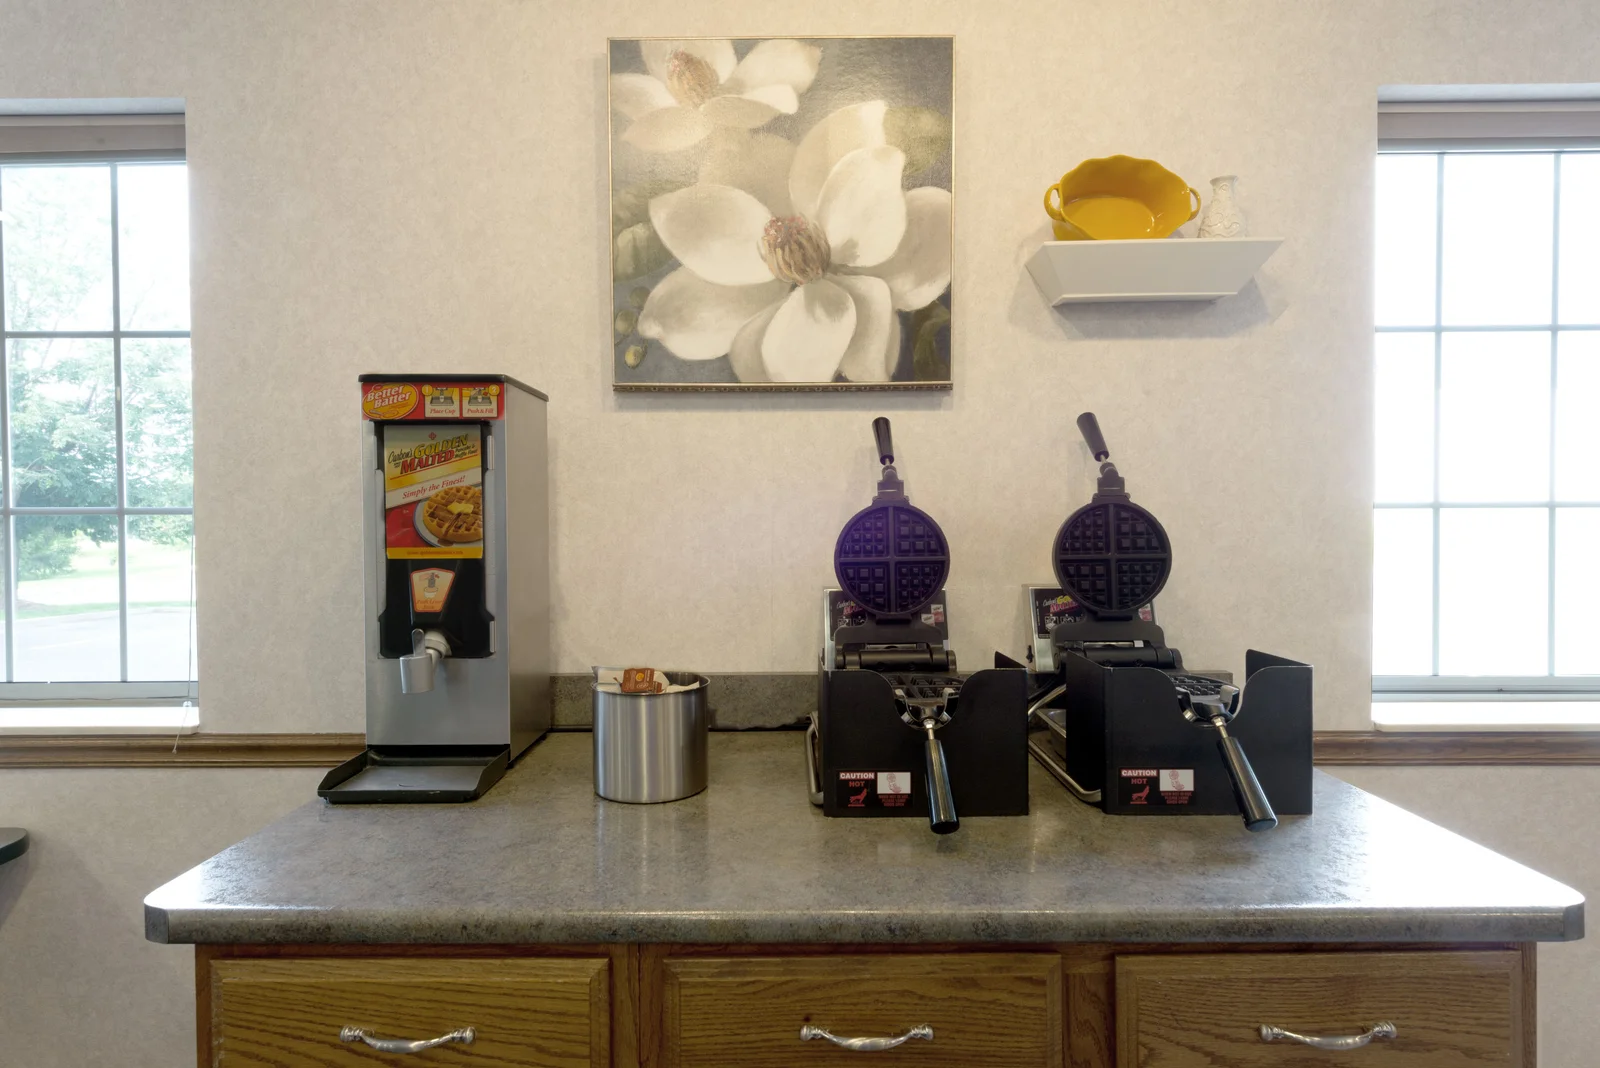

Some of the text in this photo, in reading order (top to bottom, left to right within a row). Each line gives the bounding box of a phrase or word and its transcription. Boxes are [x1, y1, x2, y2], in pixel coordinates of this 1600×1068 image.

[366, 385, 405, 402] Better
[374, 391, 411, 409] Batter
[414, 433, 469, 459] GOLDEN
[400, 449, 455, 474] MALTED
[402, 475, 466, 499] Simply the Finest!
